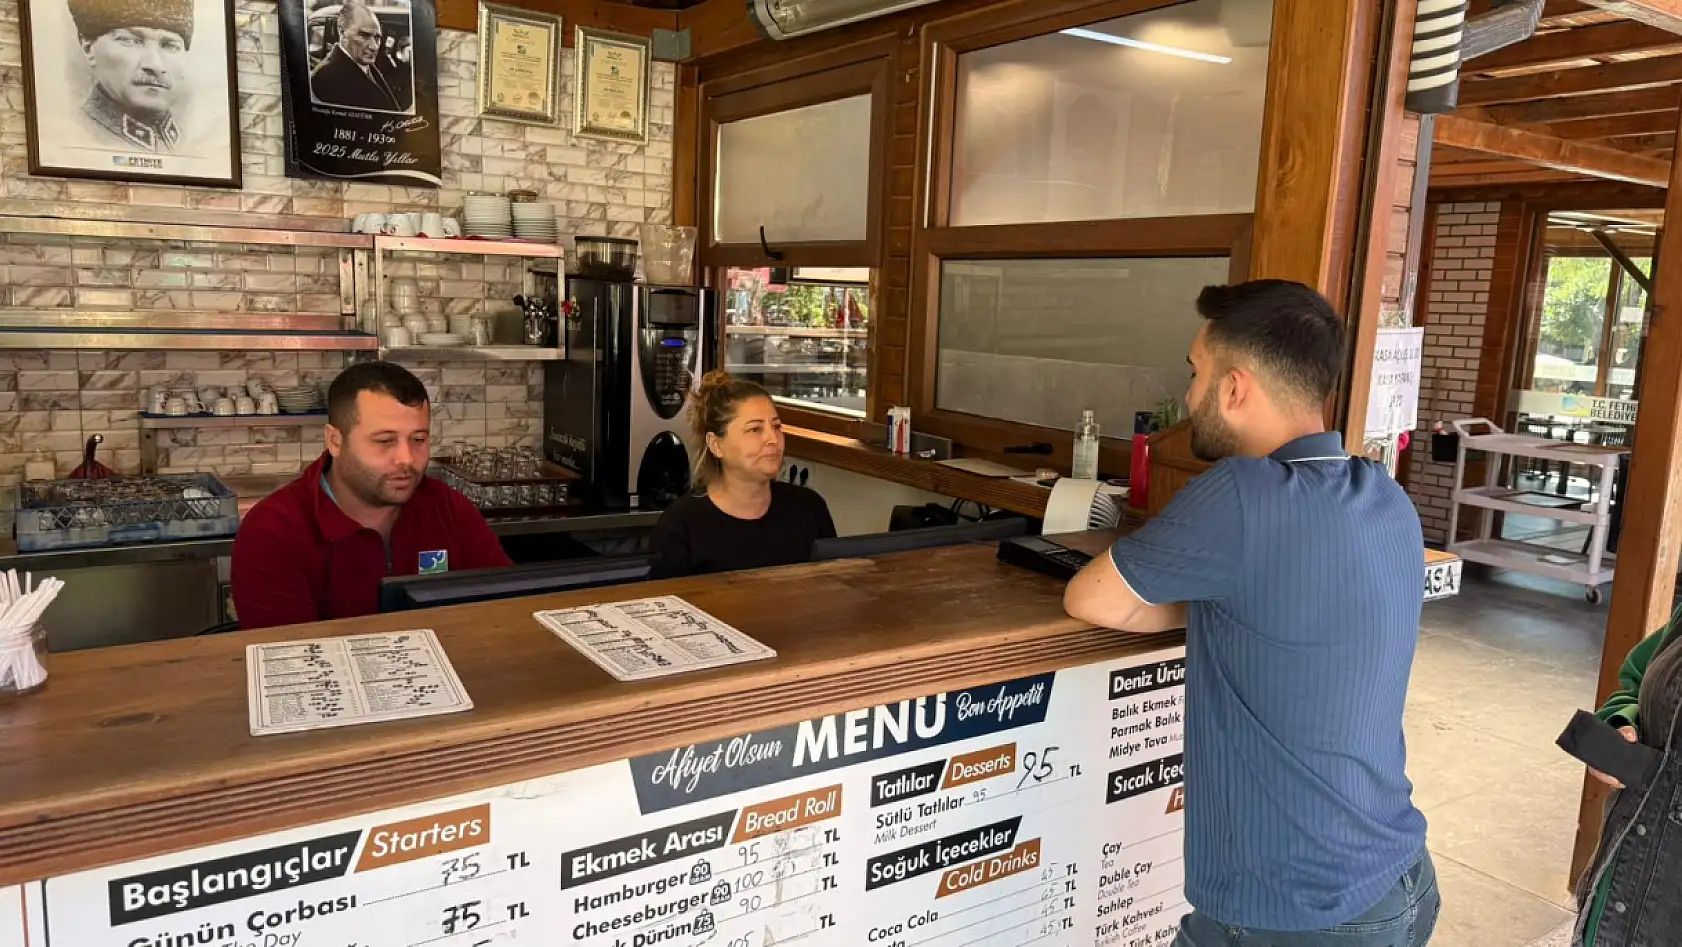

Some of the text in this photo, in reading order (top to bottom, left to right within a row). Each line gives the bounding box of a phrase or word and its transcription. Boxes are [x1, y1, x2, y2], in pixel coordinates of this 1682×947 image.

[333, 127, 357, 142] 1881
[313, 141, 348, 158] 2025
[347, 148, 380, 163] Mutlu
[1113, 670, 1153, 694] Deniz
[956, 692, 986, 722] Bon
[1112, 704, 1139, 720] Balık
[1142, 694, 1176, 713] Ekmek
[1111, 710, 1181, 739] Parmak Balık
[1109, 741, 1141, 759] Midye
[1144, 735, 1168, 749] Tava
[651, 733, 783, 794] Afiyet Olsun
[876, 753, 1011, 799] Tatlılar Desserts
[1016, 747, 1060, 790] 95
[1069, 763, 1082, 778] TL
[1113, 765, 1154, 795] Sıcak
[745, 790, 837, 833] Bread Roll
[876, 795, 965, 829] Sütlü Tatlılar
[371, 818, 483, 858] Starters
[824, 827, 840, 844] TL
[874, 819, 937, 845] Milk Dessert
[506, 851, 530, 871] TL
[571, 826, 722, 879] Ekmek Arası
[738, 841, 760, 867] 95
[822, 851, 839, 868] TL
[871, 828, 1012, 882] Soğuk İçecekler
[1102, 841, 1122, 859] Çay
[947, 849, 1038, 890] Cold Drinks
[1066, 863, 1078, 876] TL
[1098, 861, 1153, 887] Duble Çay
[1101, 859, 1114, 869] Tea
[122, 845, 348, 912] Başlangıçlar
[733, 870, 764, 894] 100
[821, 874, 838, 891] TL
[1065, 879, 1077, 892] TL
[1097, 879, 1140, 900] Double Tea
[574, 871, 688, 914] Hamburger
[739, 895, 762, 915] 90
[1063, 896, 1075, 910] TL
[247, 894, 358, 937] Çorbası
[506, 901, 530, 921] TL
[572, 891, 709, 941] Cheeseburger
[1095, 901, 1164, 937] Türk Kahvesi
[1096, 896, 1133, 917] Sahlep
[633, 921, 692, 947] Dürüm
[819, 913, 836, 929] TL
[868, 910, 938, 942] Coca Cola
[1062, 916, 1073, 930] TL
[1122, 922, 1147, 938] Coffee
